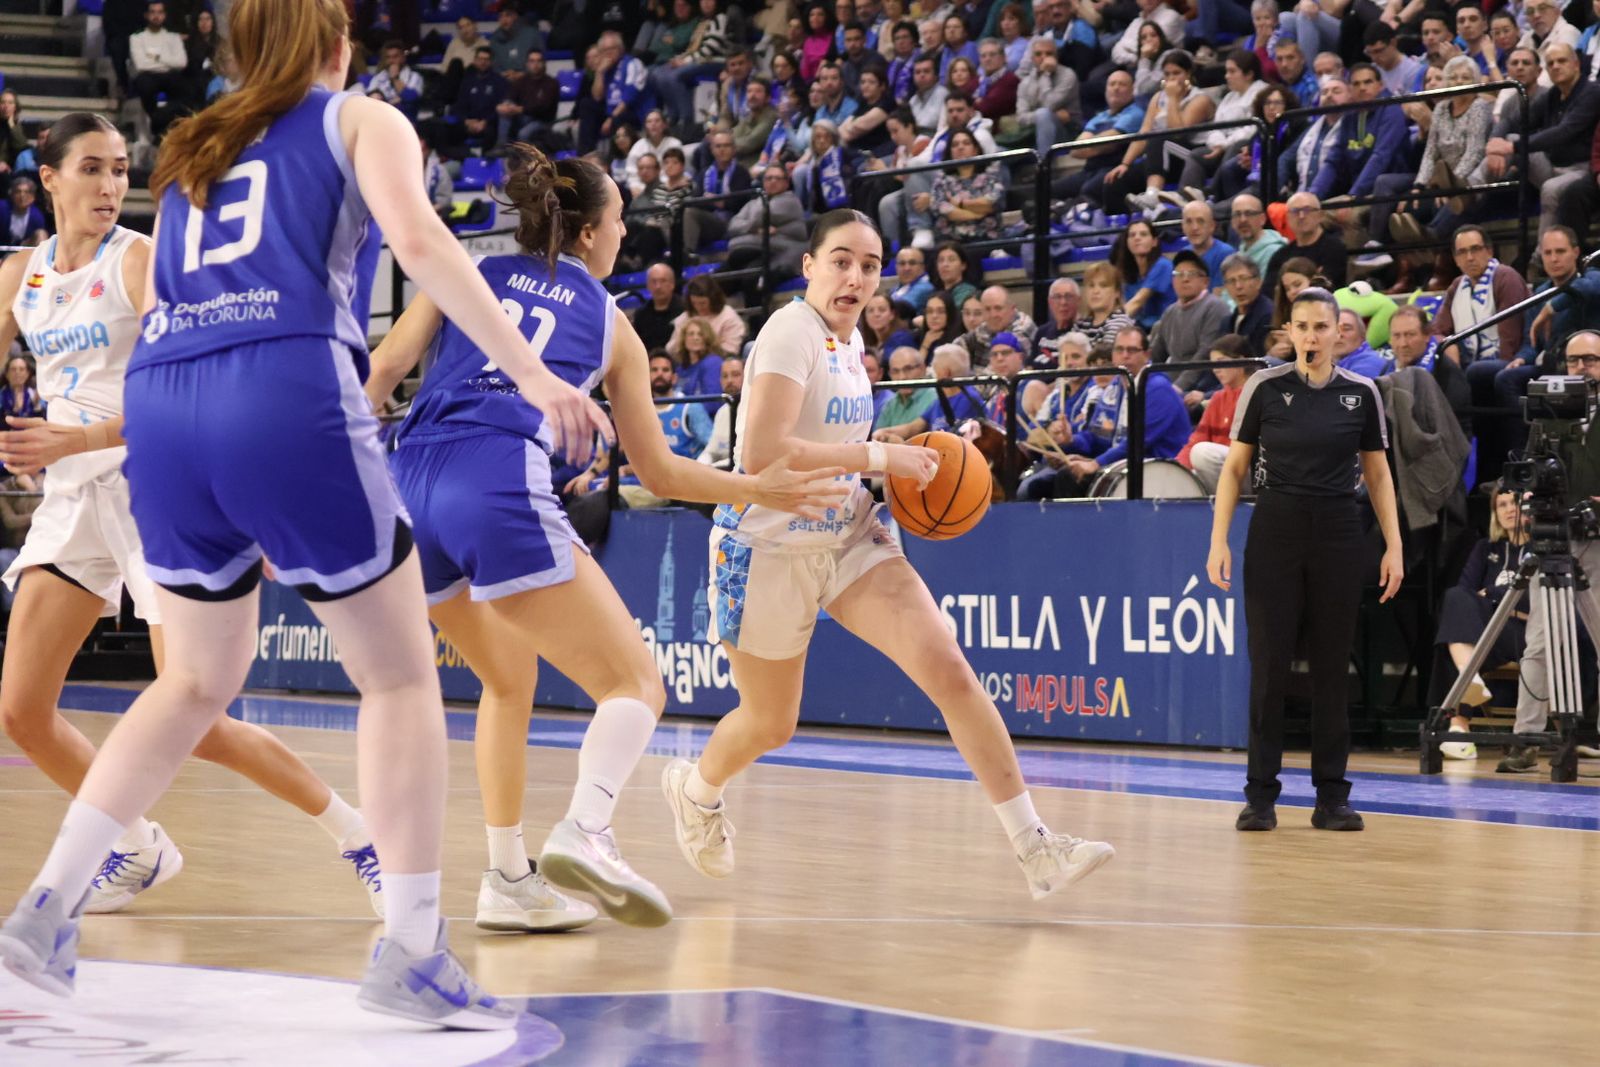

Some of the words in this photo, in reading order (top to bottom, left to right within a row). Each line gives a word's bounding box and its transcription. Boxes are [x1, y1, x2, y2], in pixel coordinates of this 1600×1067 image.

[183, 159, 268, 274] 13
[173, 287, 280, 316] Deputación
[506, 273, 576, 306] MILLÁN
[171, 316, 194, 333] DA
[198, 302, 277, 327] CORUÑA
[62, 366, 79, 399] 7
[1080, 596, 1106, 665] Y
[1123, 574, 1235, 656] LEÓN
[980, 671, 1013, 702] OS
[1016, 673, 1131, 723] IMPULSA
